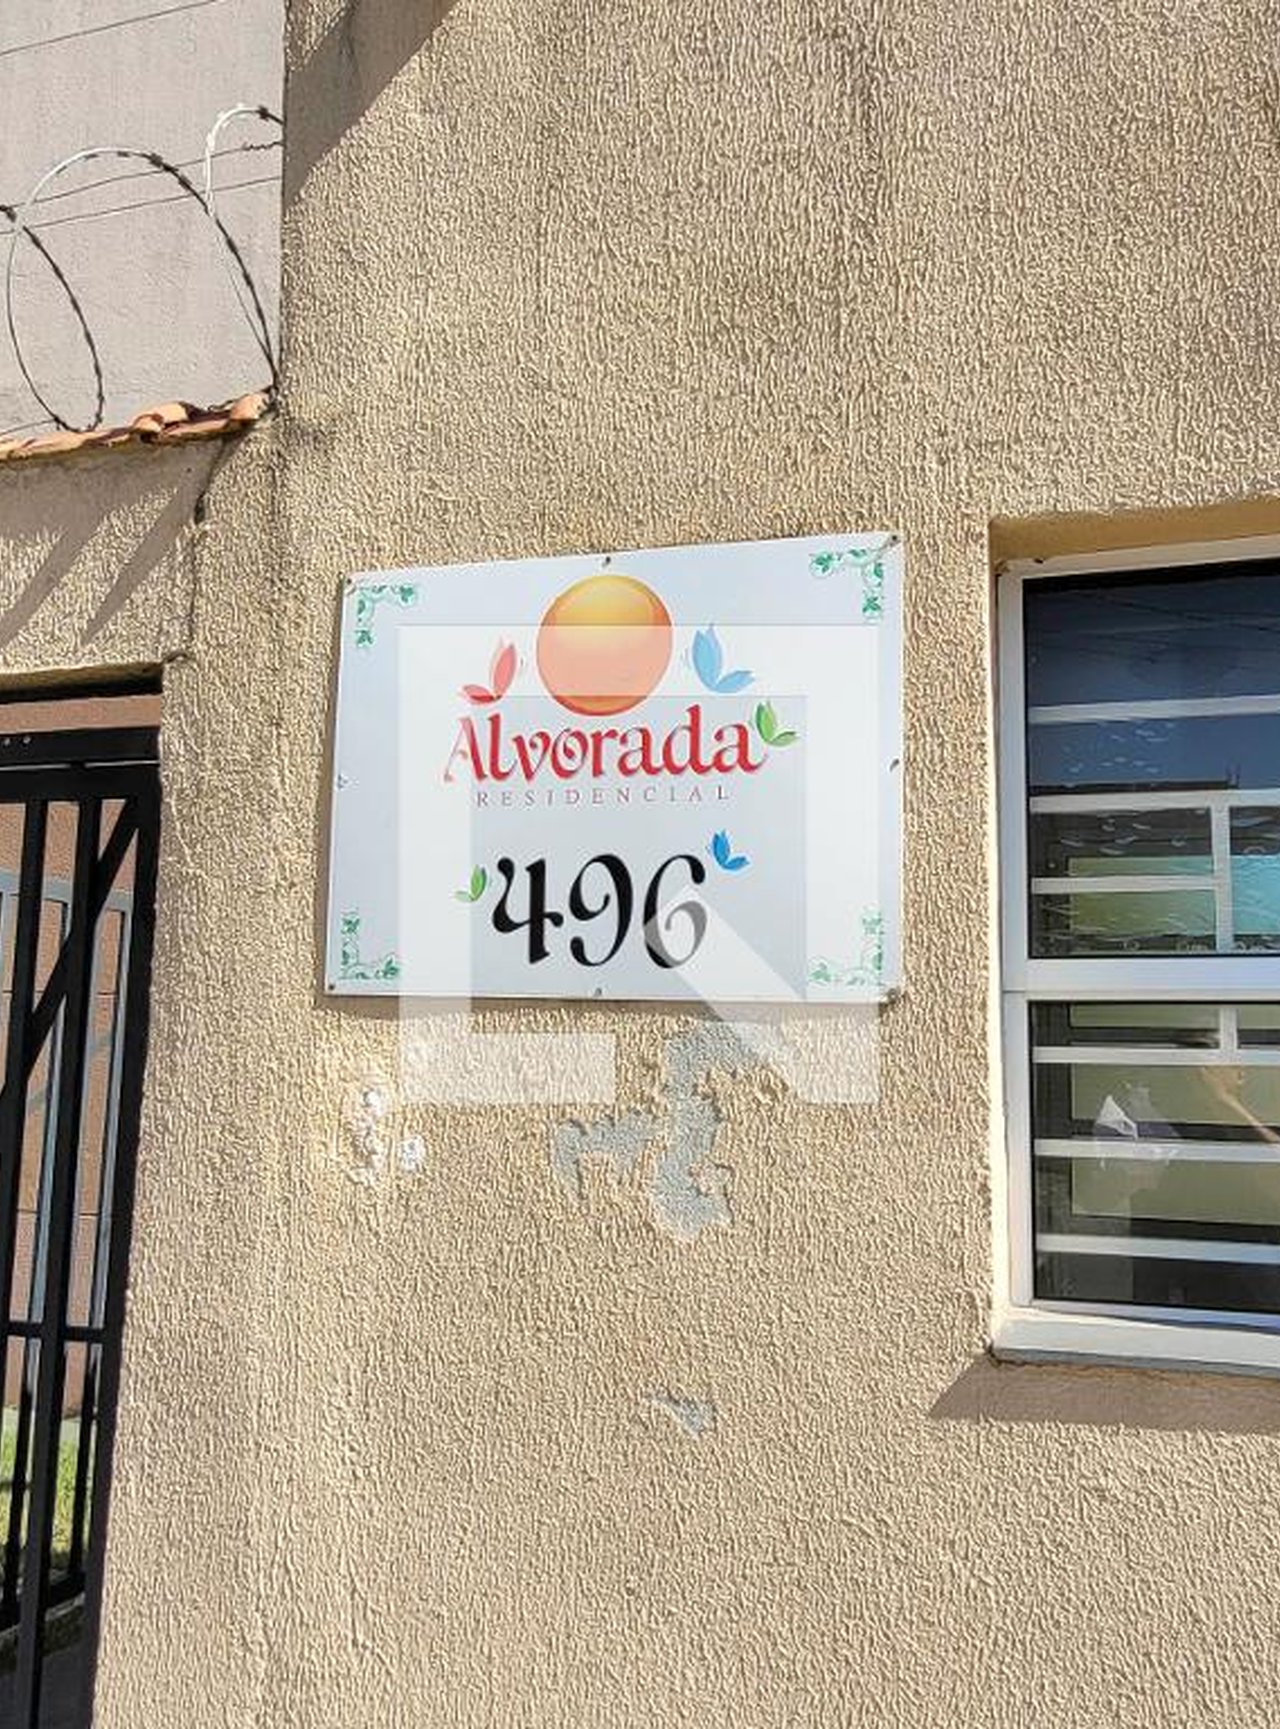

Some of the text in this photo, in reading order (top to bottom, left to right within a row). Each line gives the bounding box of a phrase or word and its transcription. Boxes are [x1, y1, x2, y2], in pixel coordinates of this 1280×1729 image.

[442, 703, 770, 784] Alvorada
[476, 786, 730, 808] RESIDENCIAL
[491, 853, 708, 970] 496
